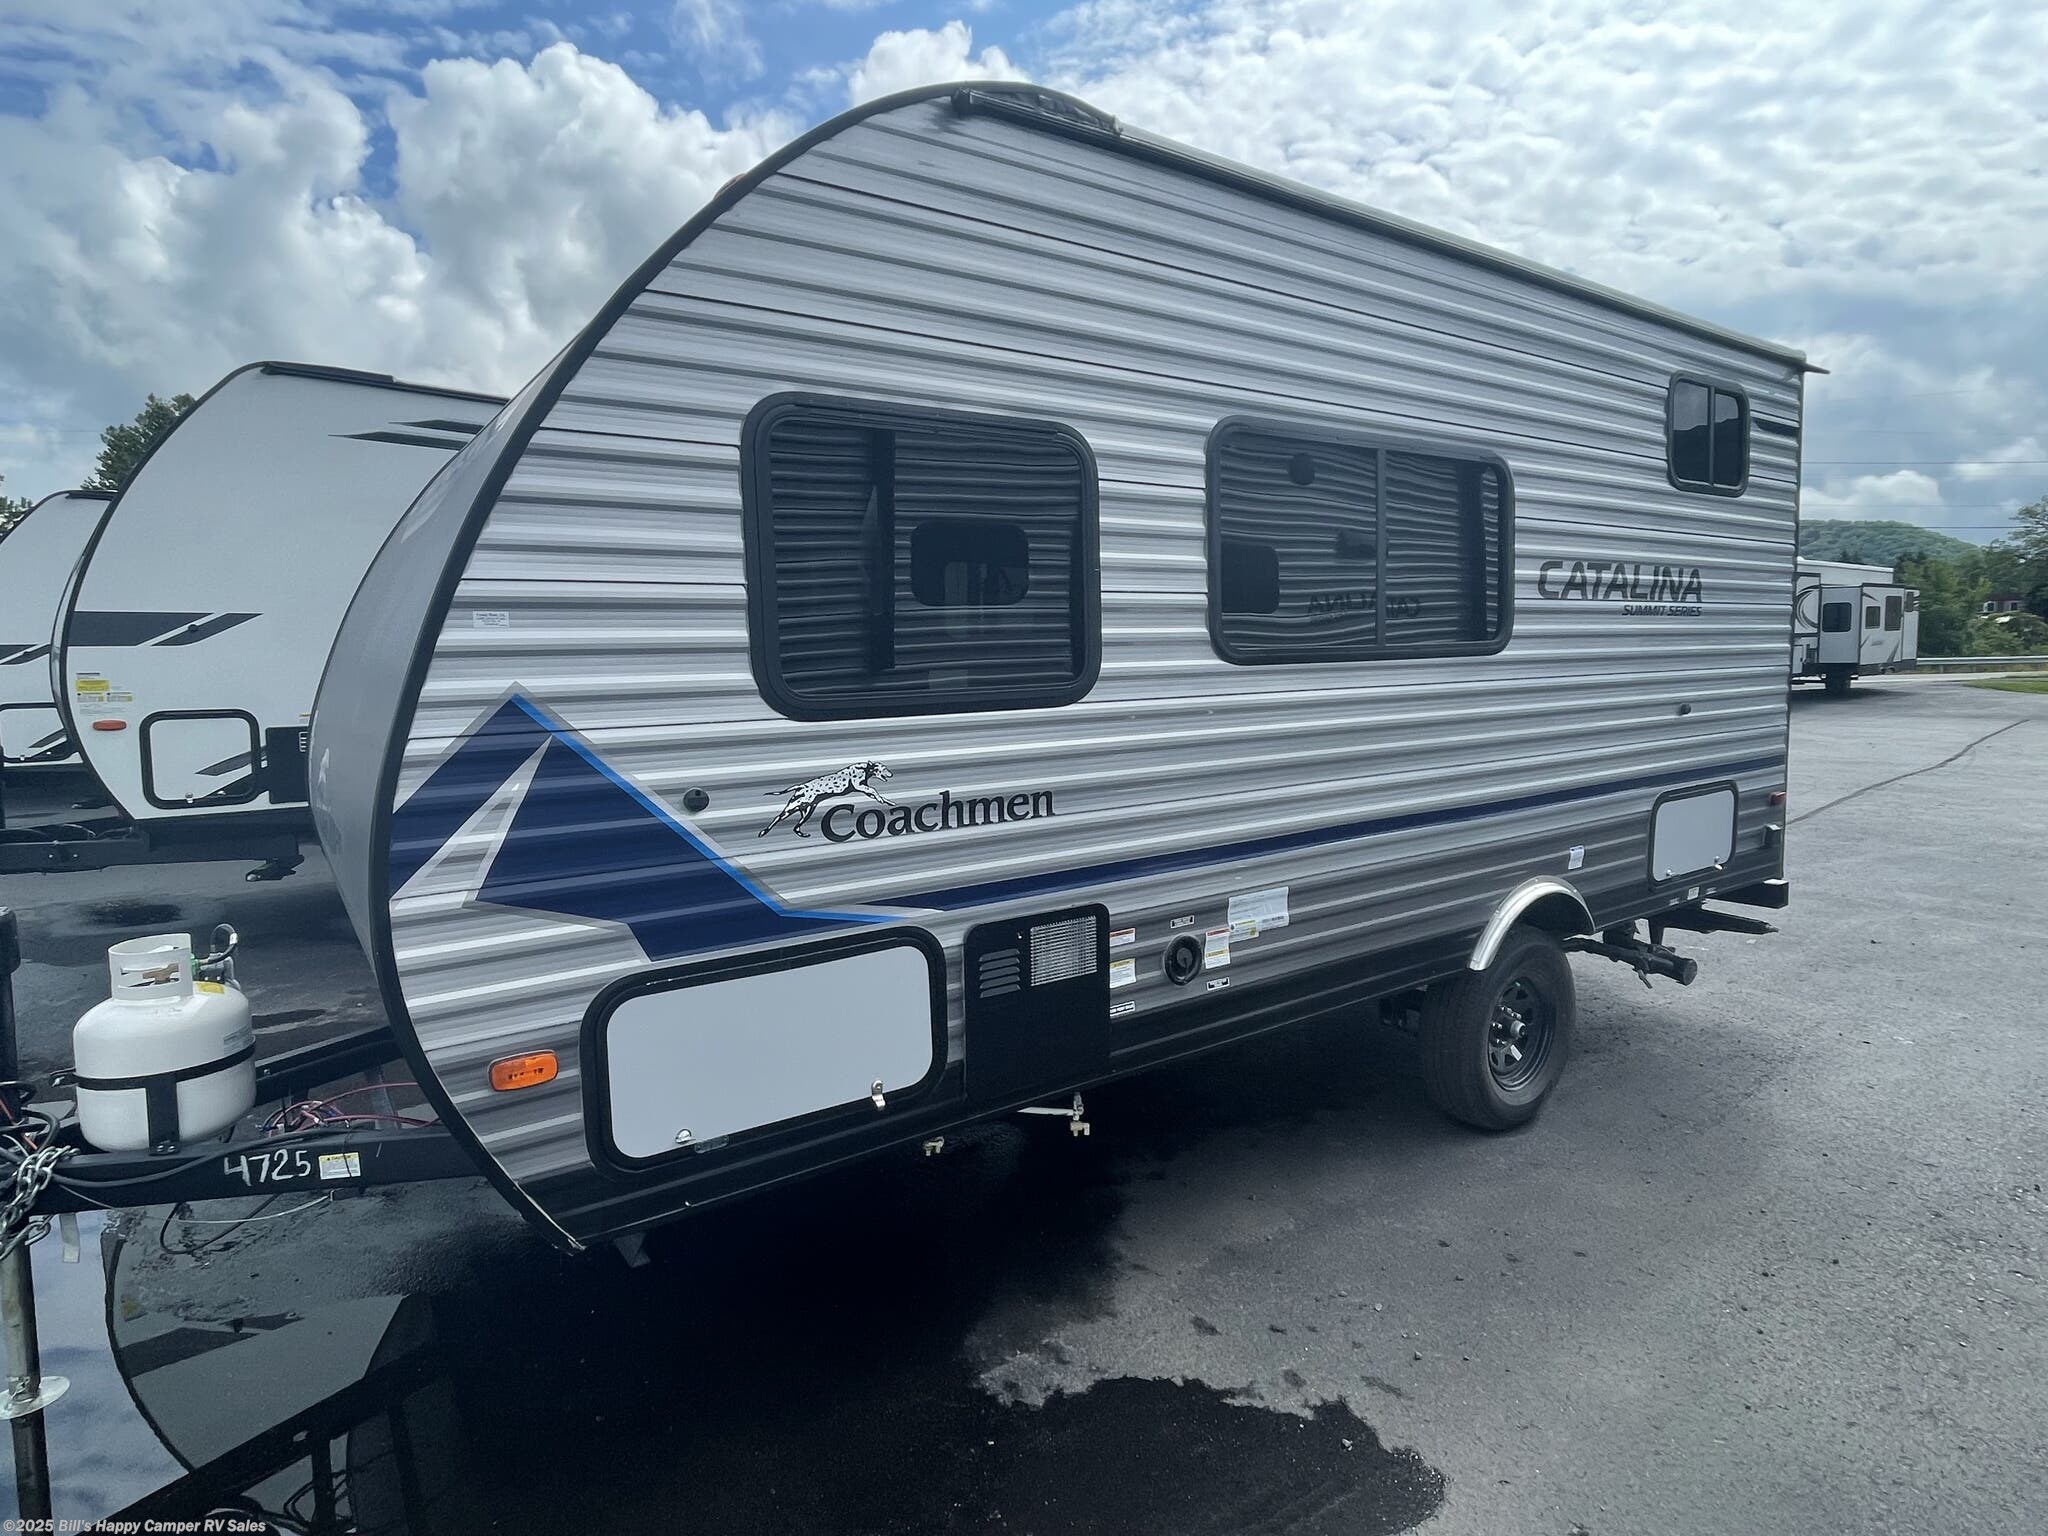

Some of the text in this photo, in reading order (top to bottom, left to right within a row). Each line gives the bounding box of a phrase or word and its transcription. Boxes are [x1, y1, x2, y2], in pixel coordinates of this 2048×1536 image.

[1537, 561, 1702, 602] CATALINA
[1622, 605, 1702, 617] SUMMIT SERIES
[820, 790, 1055, 843] Coachmen
[224, 1149, 312, 1187] 4725
